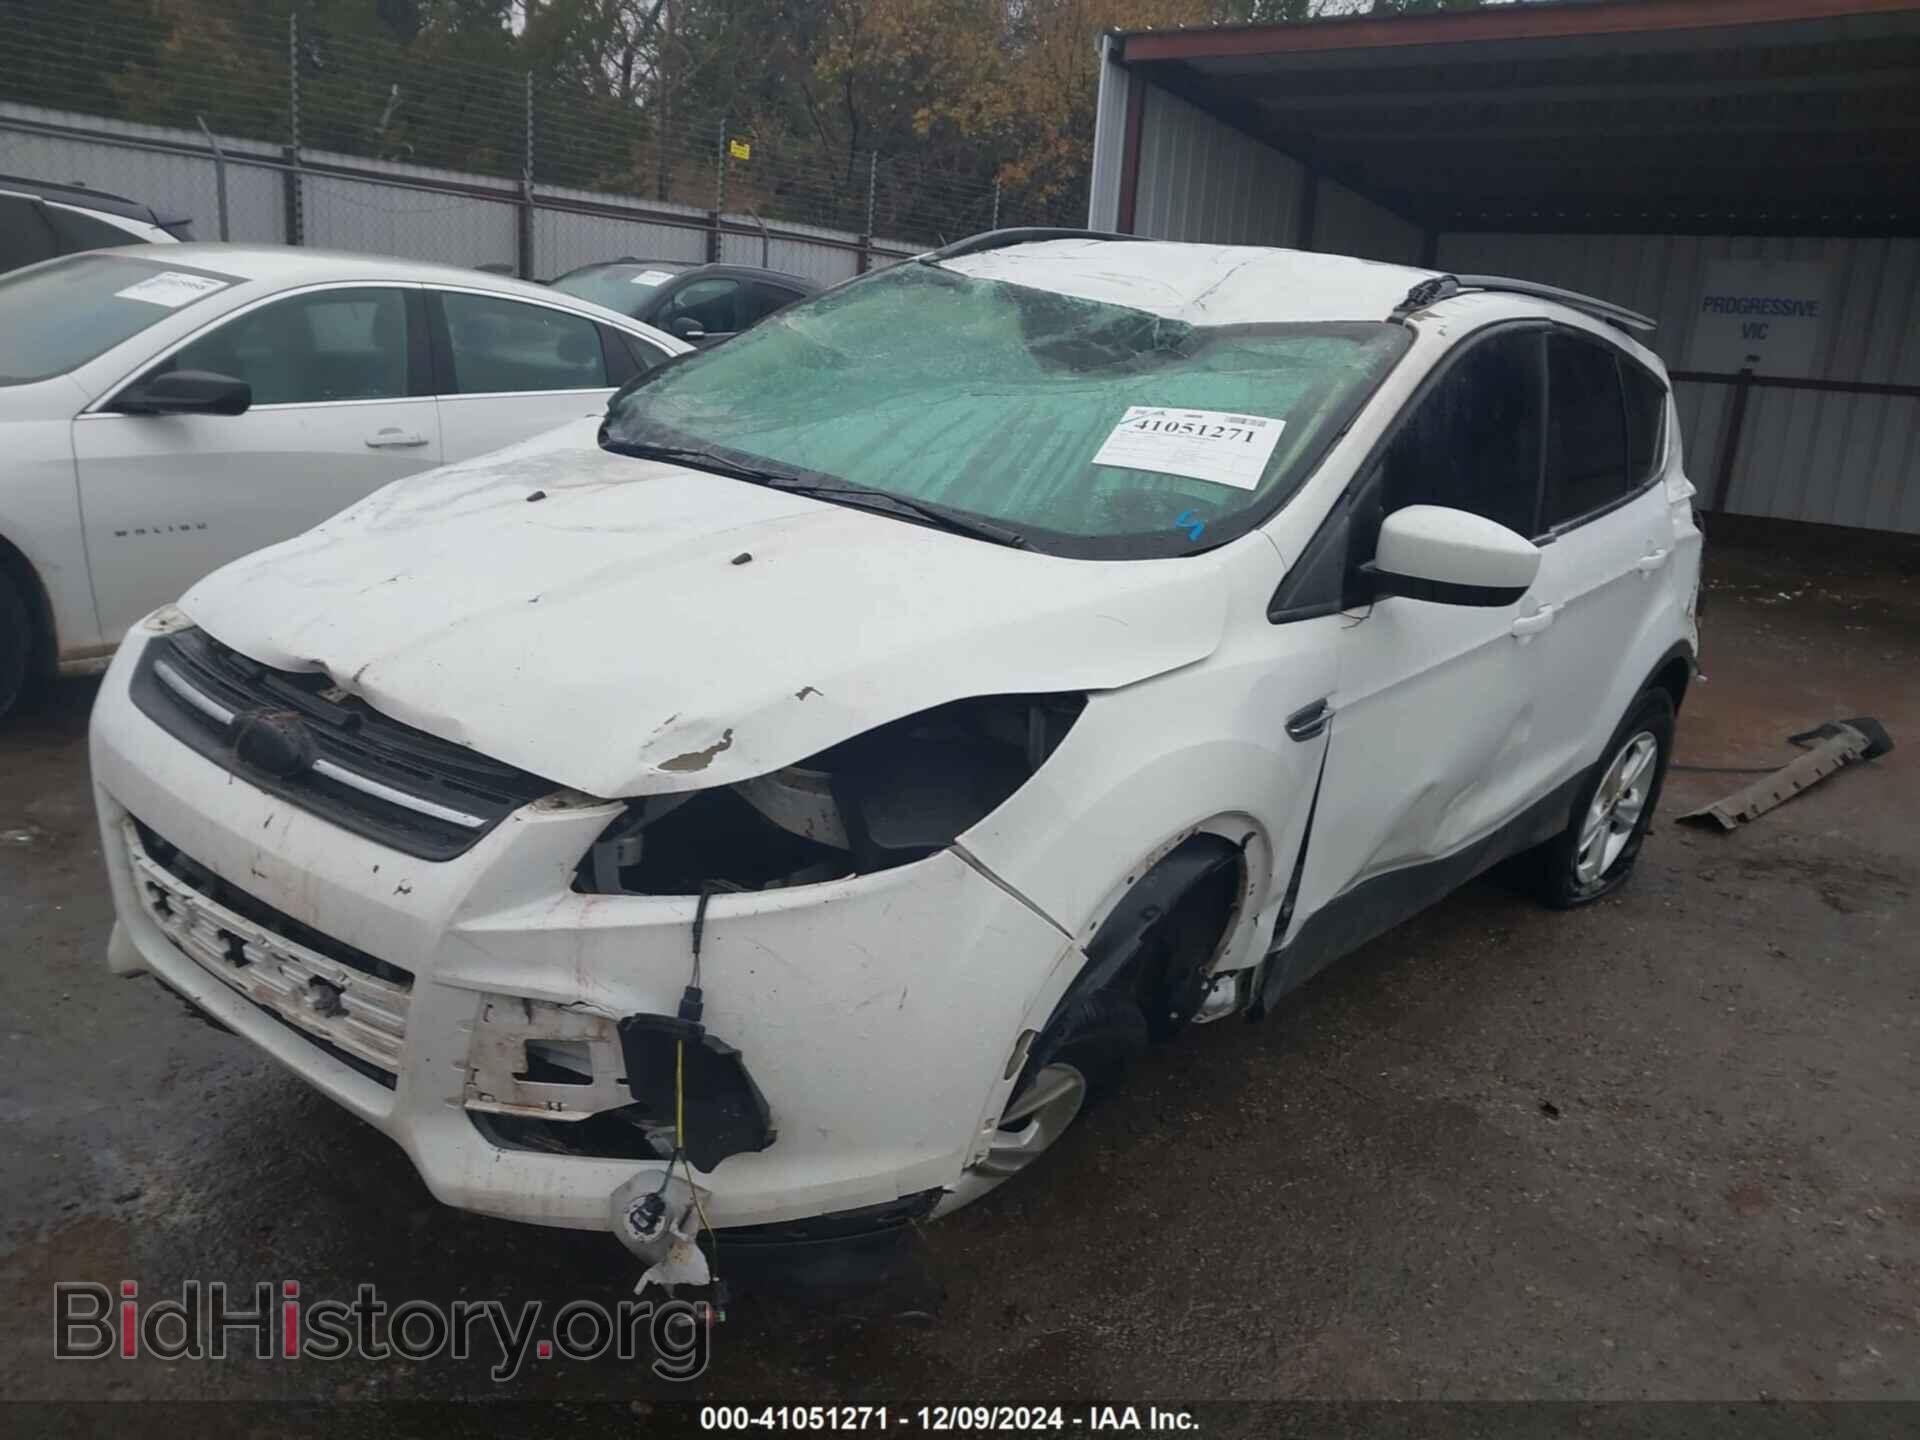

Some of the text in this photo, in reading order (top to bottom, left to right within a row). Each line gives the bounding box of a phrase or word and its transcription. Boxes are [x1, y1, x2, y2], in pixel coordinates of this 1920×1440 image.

[1702, 295, 1820, 318] PROGRESSIVE
[1742, 322, 1768, 340] VIC
[1132, 419, 1257, 443] 41051271
